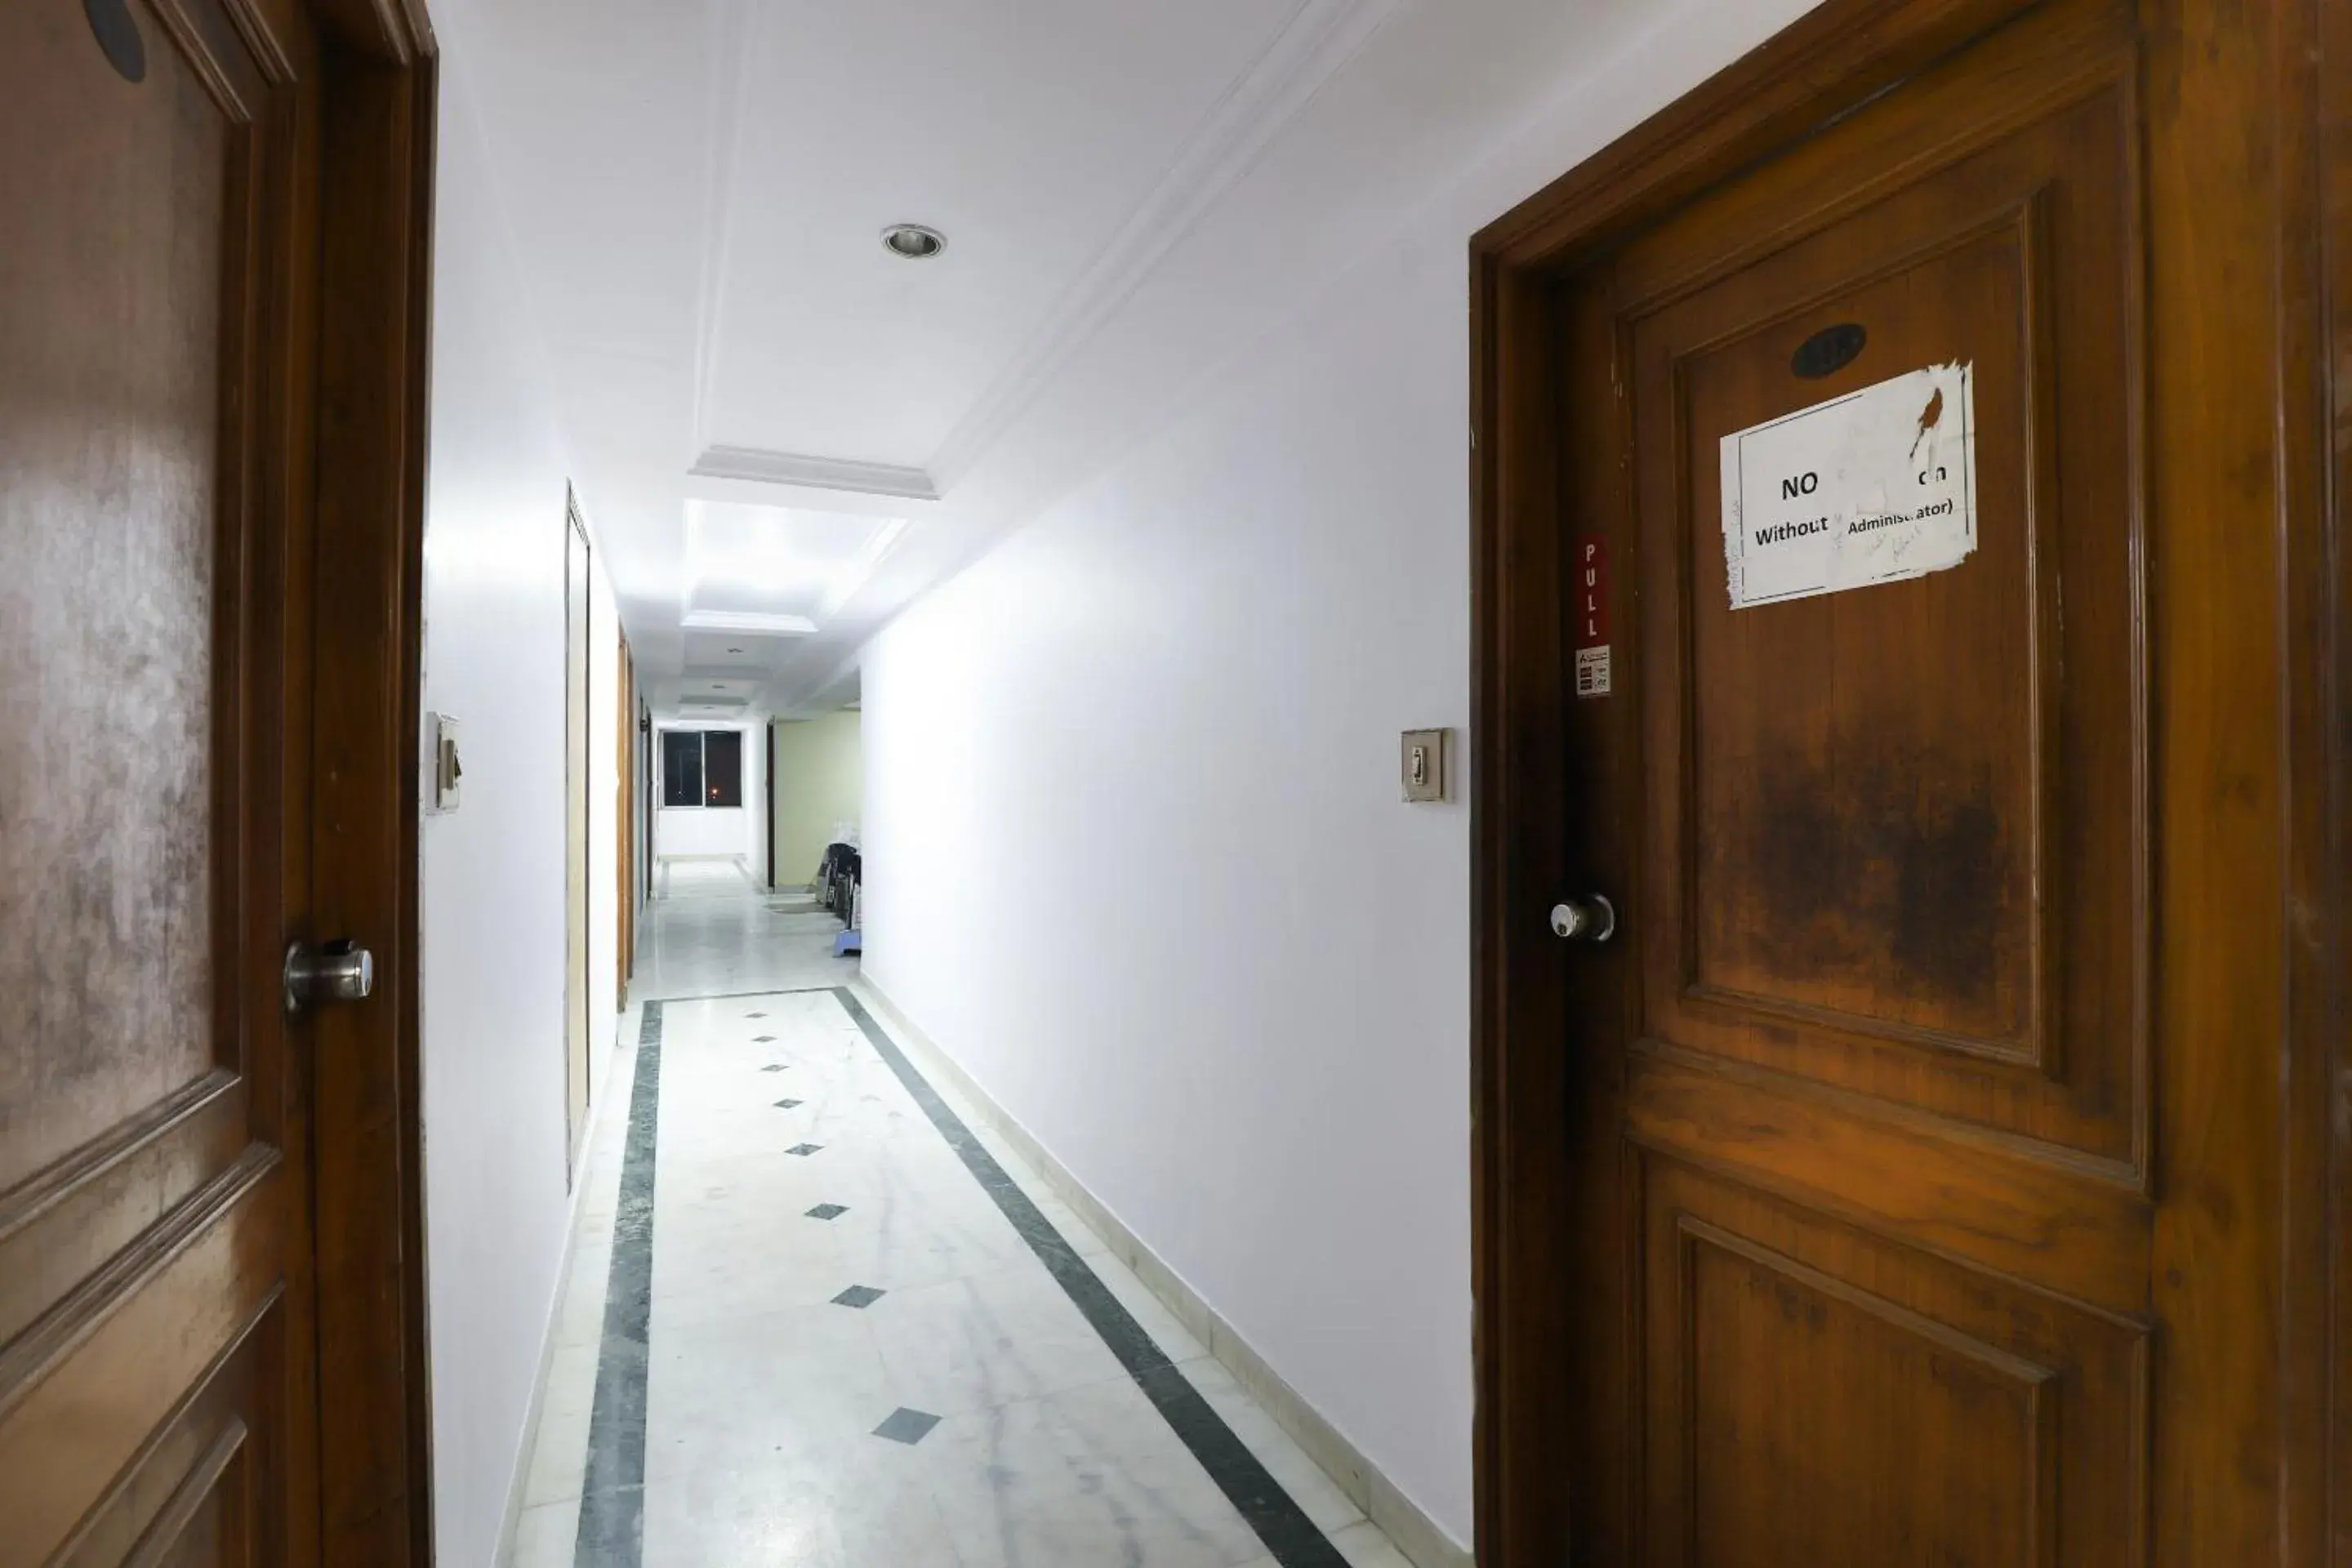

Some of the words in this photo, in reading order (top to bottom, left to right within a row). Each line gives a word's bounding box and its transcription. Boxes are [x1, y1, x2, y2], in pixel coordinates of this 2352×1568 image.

[1783, 472, 1818, 500] NO
[1756, 517, 1829, 546] Without
[1848, 497, 1953, 535] Adminisator)
[1585, 543, 1597, 637] PULL
